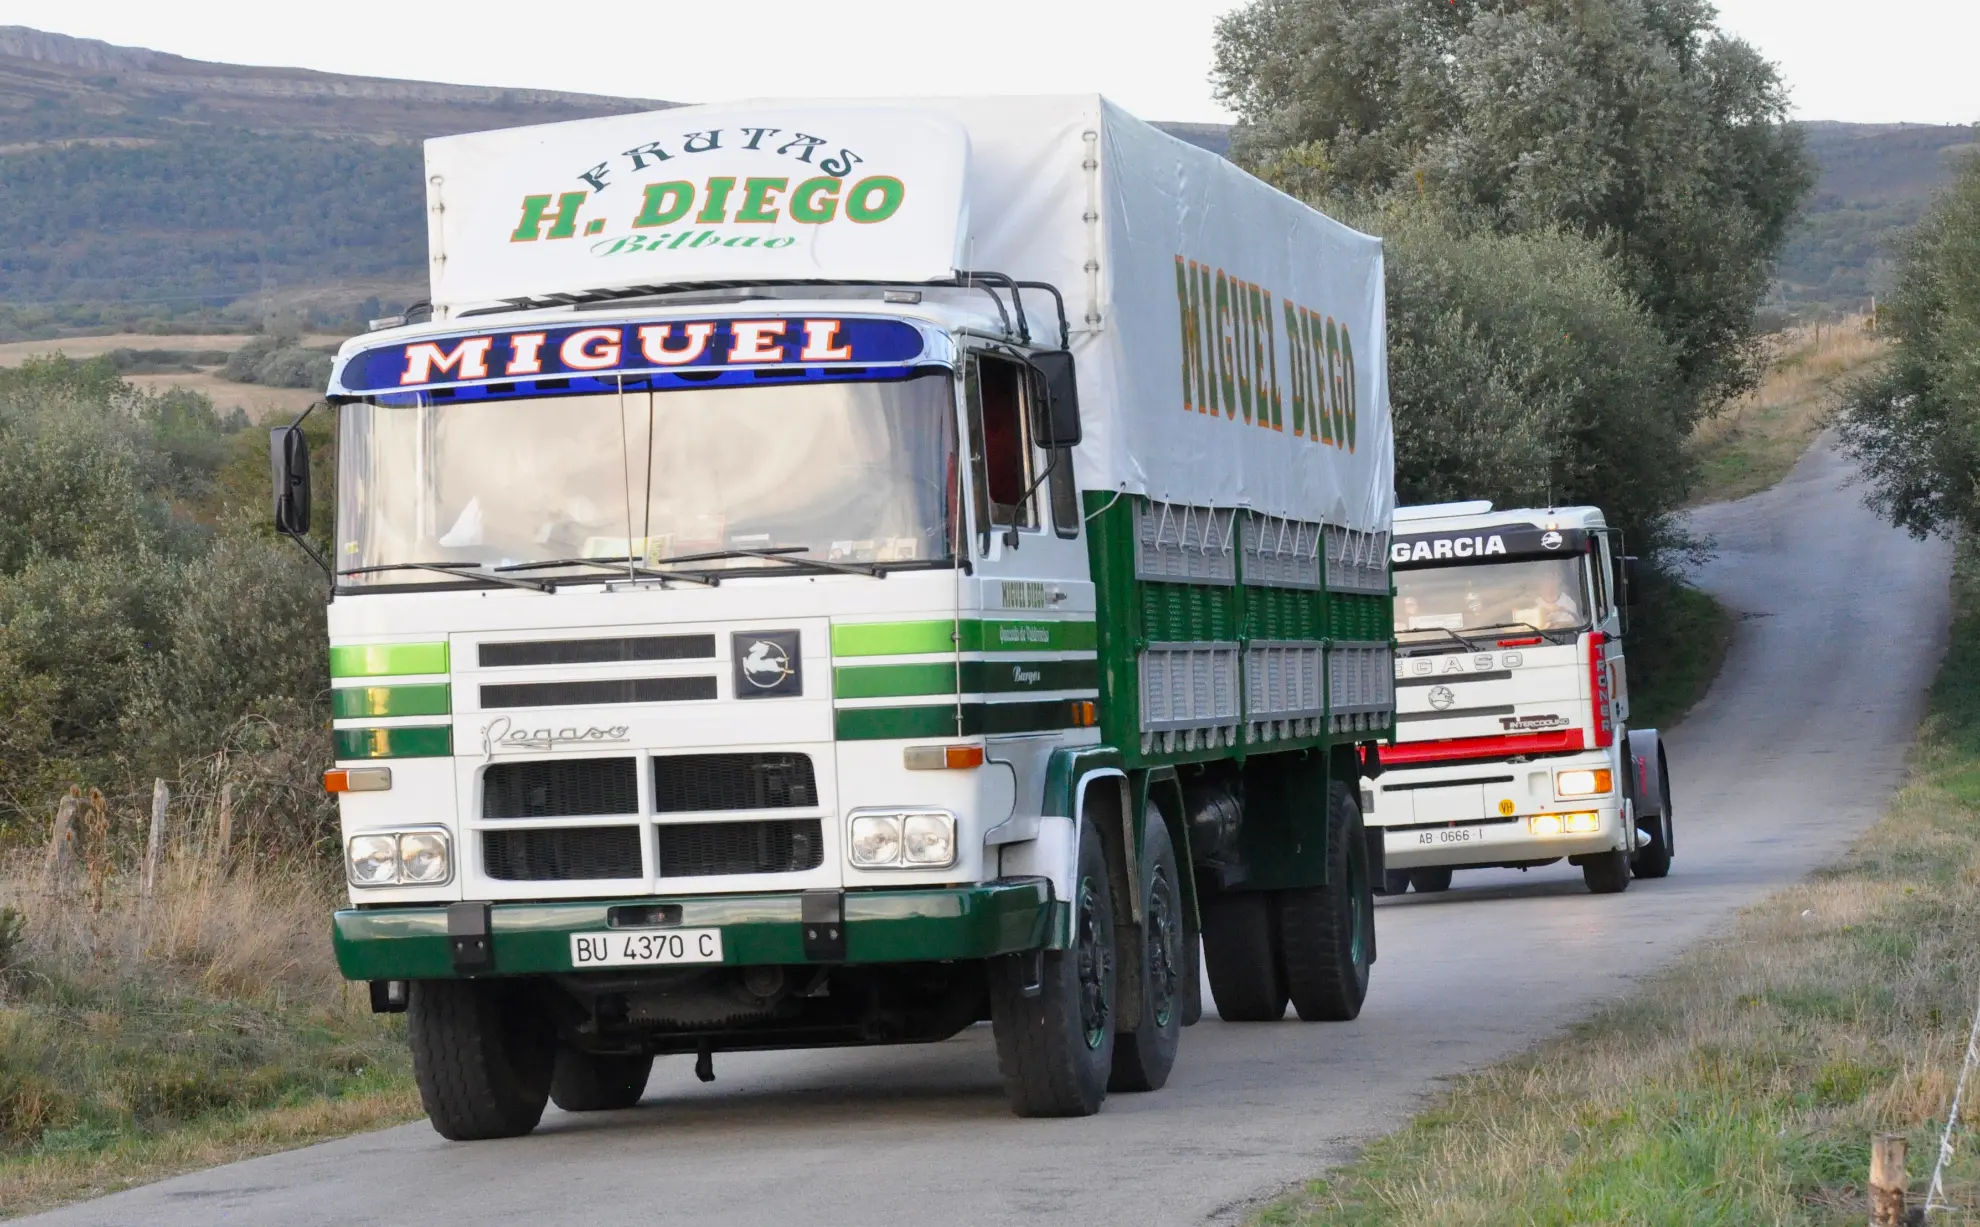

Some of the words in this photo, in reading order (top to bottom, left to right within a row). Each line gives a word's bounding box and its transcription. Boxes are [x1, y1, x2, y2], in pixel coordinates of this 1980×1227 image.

[577, 128, 864, 193] FRUTAS
[510, 190, 606, 243] H.
[632, 175, 905, 229] DIEGO
[589, 230, 797, 257] Bilbao
[400, 319, 852, 384] MIGUEL
[1175, 254, 1283, 433] MIGUEL
[1284, 298, 1356, 454] DIEGO
[1391, 535, 1506, 562] GARCIA
[1395, 651, 1523, 677] GASO
[480, 715, 630, 762] Pegaso
[1501, 802, 1513, 813] VH
[577, 937, 608, 962] BU
[623, 935, 684, 960] 4370
[698, 934, 714, 957] C
